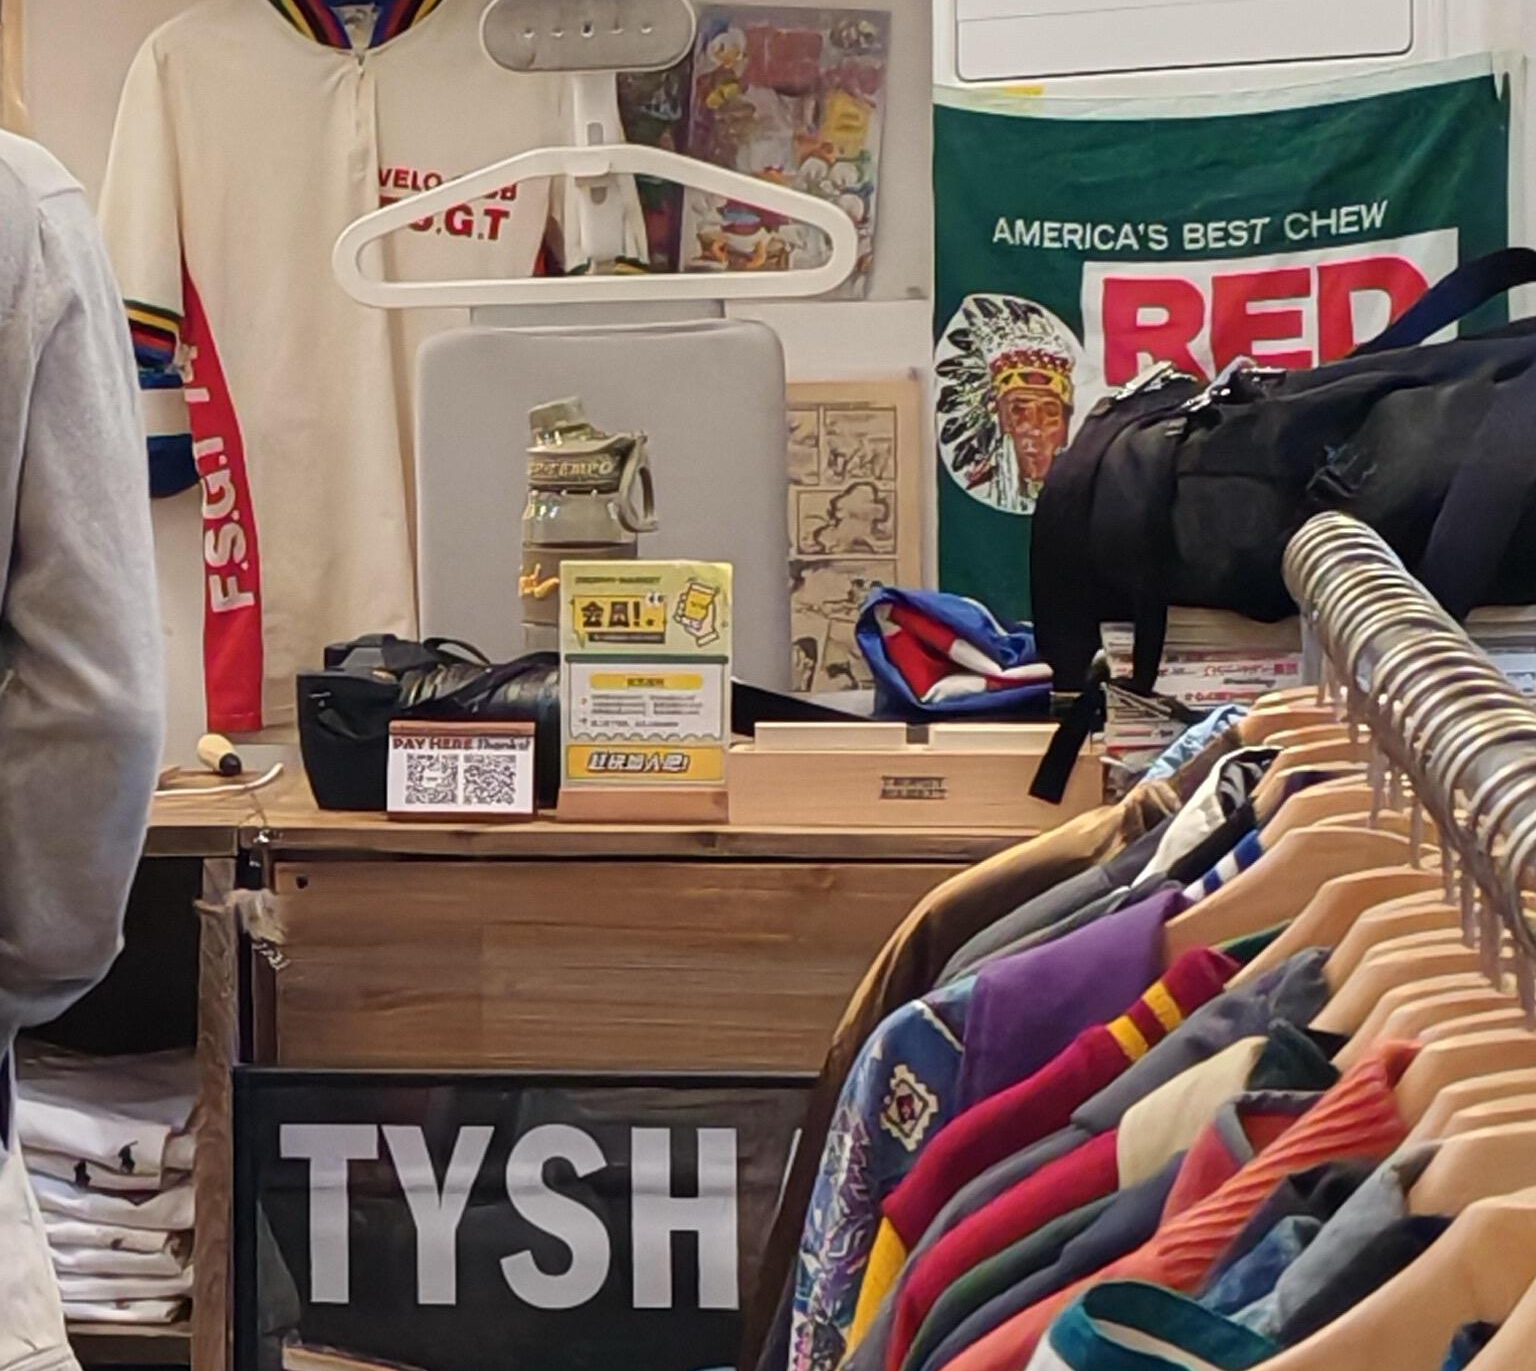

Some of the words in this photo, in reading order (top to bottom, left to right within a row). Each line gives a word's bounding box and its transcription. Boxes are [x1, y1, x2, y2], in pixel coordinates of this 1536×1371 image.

[378, 167, 444, 192] VELO
[993, 216, 1169, 251] AMERICA'S
[1182, 216, 1270, 251] BEST
[1283, 200, 1389, 244] CHEW
[1102, 254, 1430, 388] RED
[392, 736, 427, 750] PAY
[429, 735, 474, 751] HERE
[279, 1122, 802, 1310] TYSH
